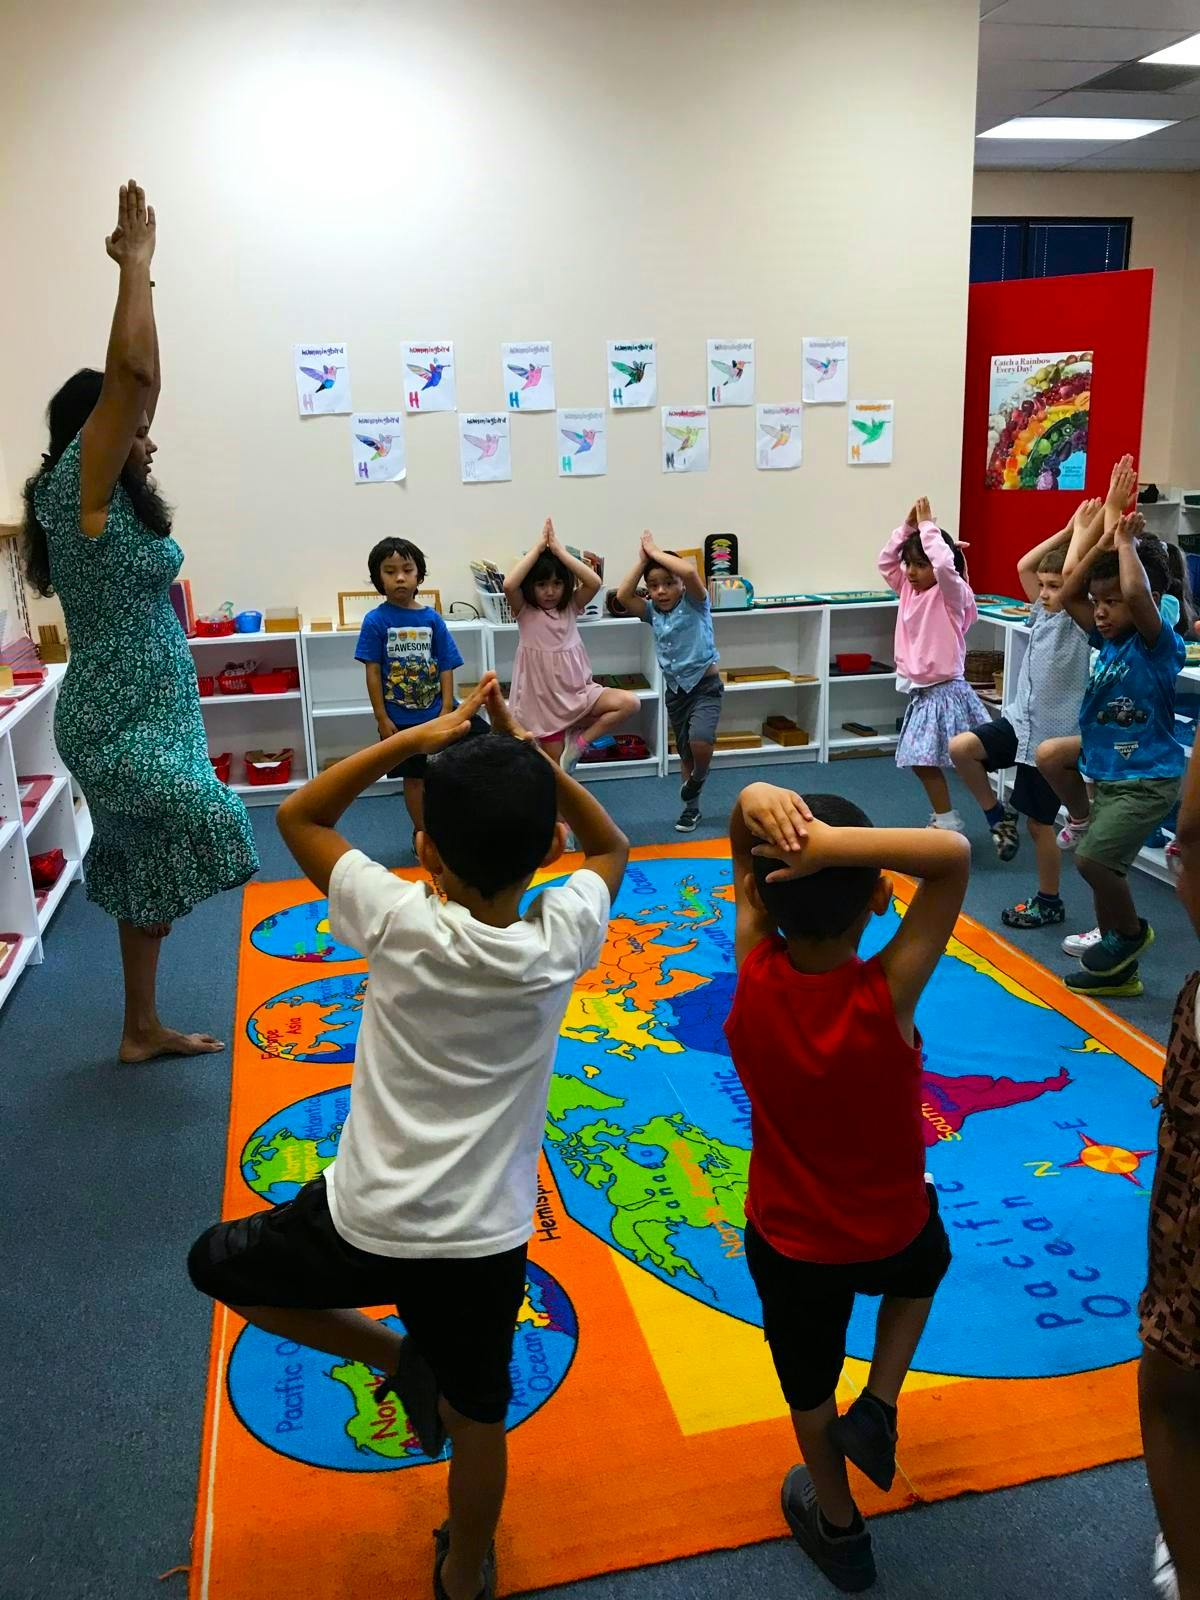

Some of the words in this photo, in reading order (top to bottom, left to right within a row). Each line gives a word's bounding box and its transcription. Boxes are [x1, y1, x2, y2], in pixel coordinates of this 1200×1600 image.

[409, 391, 420, 408] H
[509, 391, 520, 408] H
[358, 461, 369, 478] H
[286, 1017, 302, 1035] Asia
[261, 1029, 284, 1060] Europe
[304, 1097, 322, 1139] Atlantic
[1054, 1116, 1089, 1132] E
[1023, 1161, 1061, 1177] N
[936, 1180, 1085, 1330] Pacific
[1001, 1195, 1133, 1319] Ocean
[524, 1331, 554, 1391] Ocean
[276, 1362, 305, 1434] Pacific
